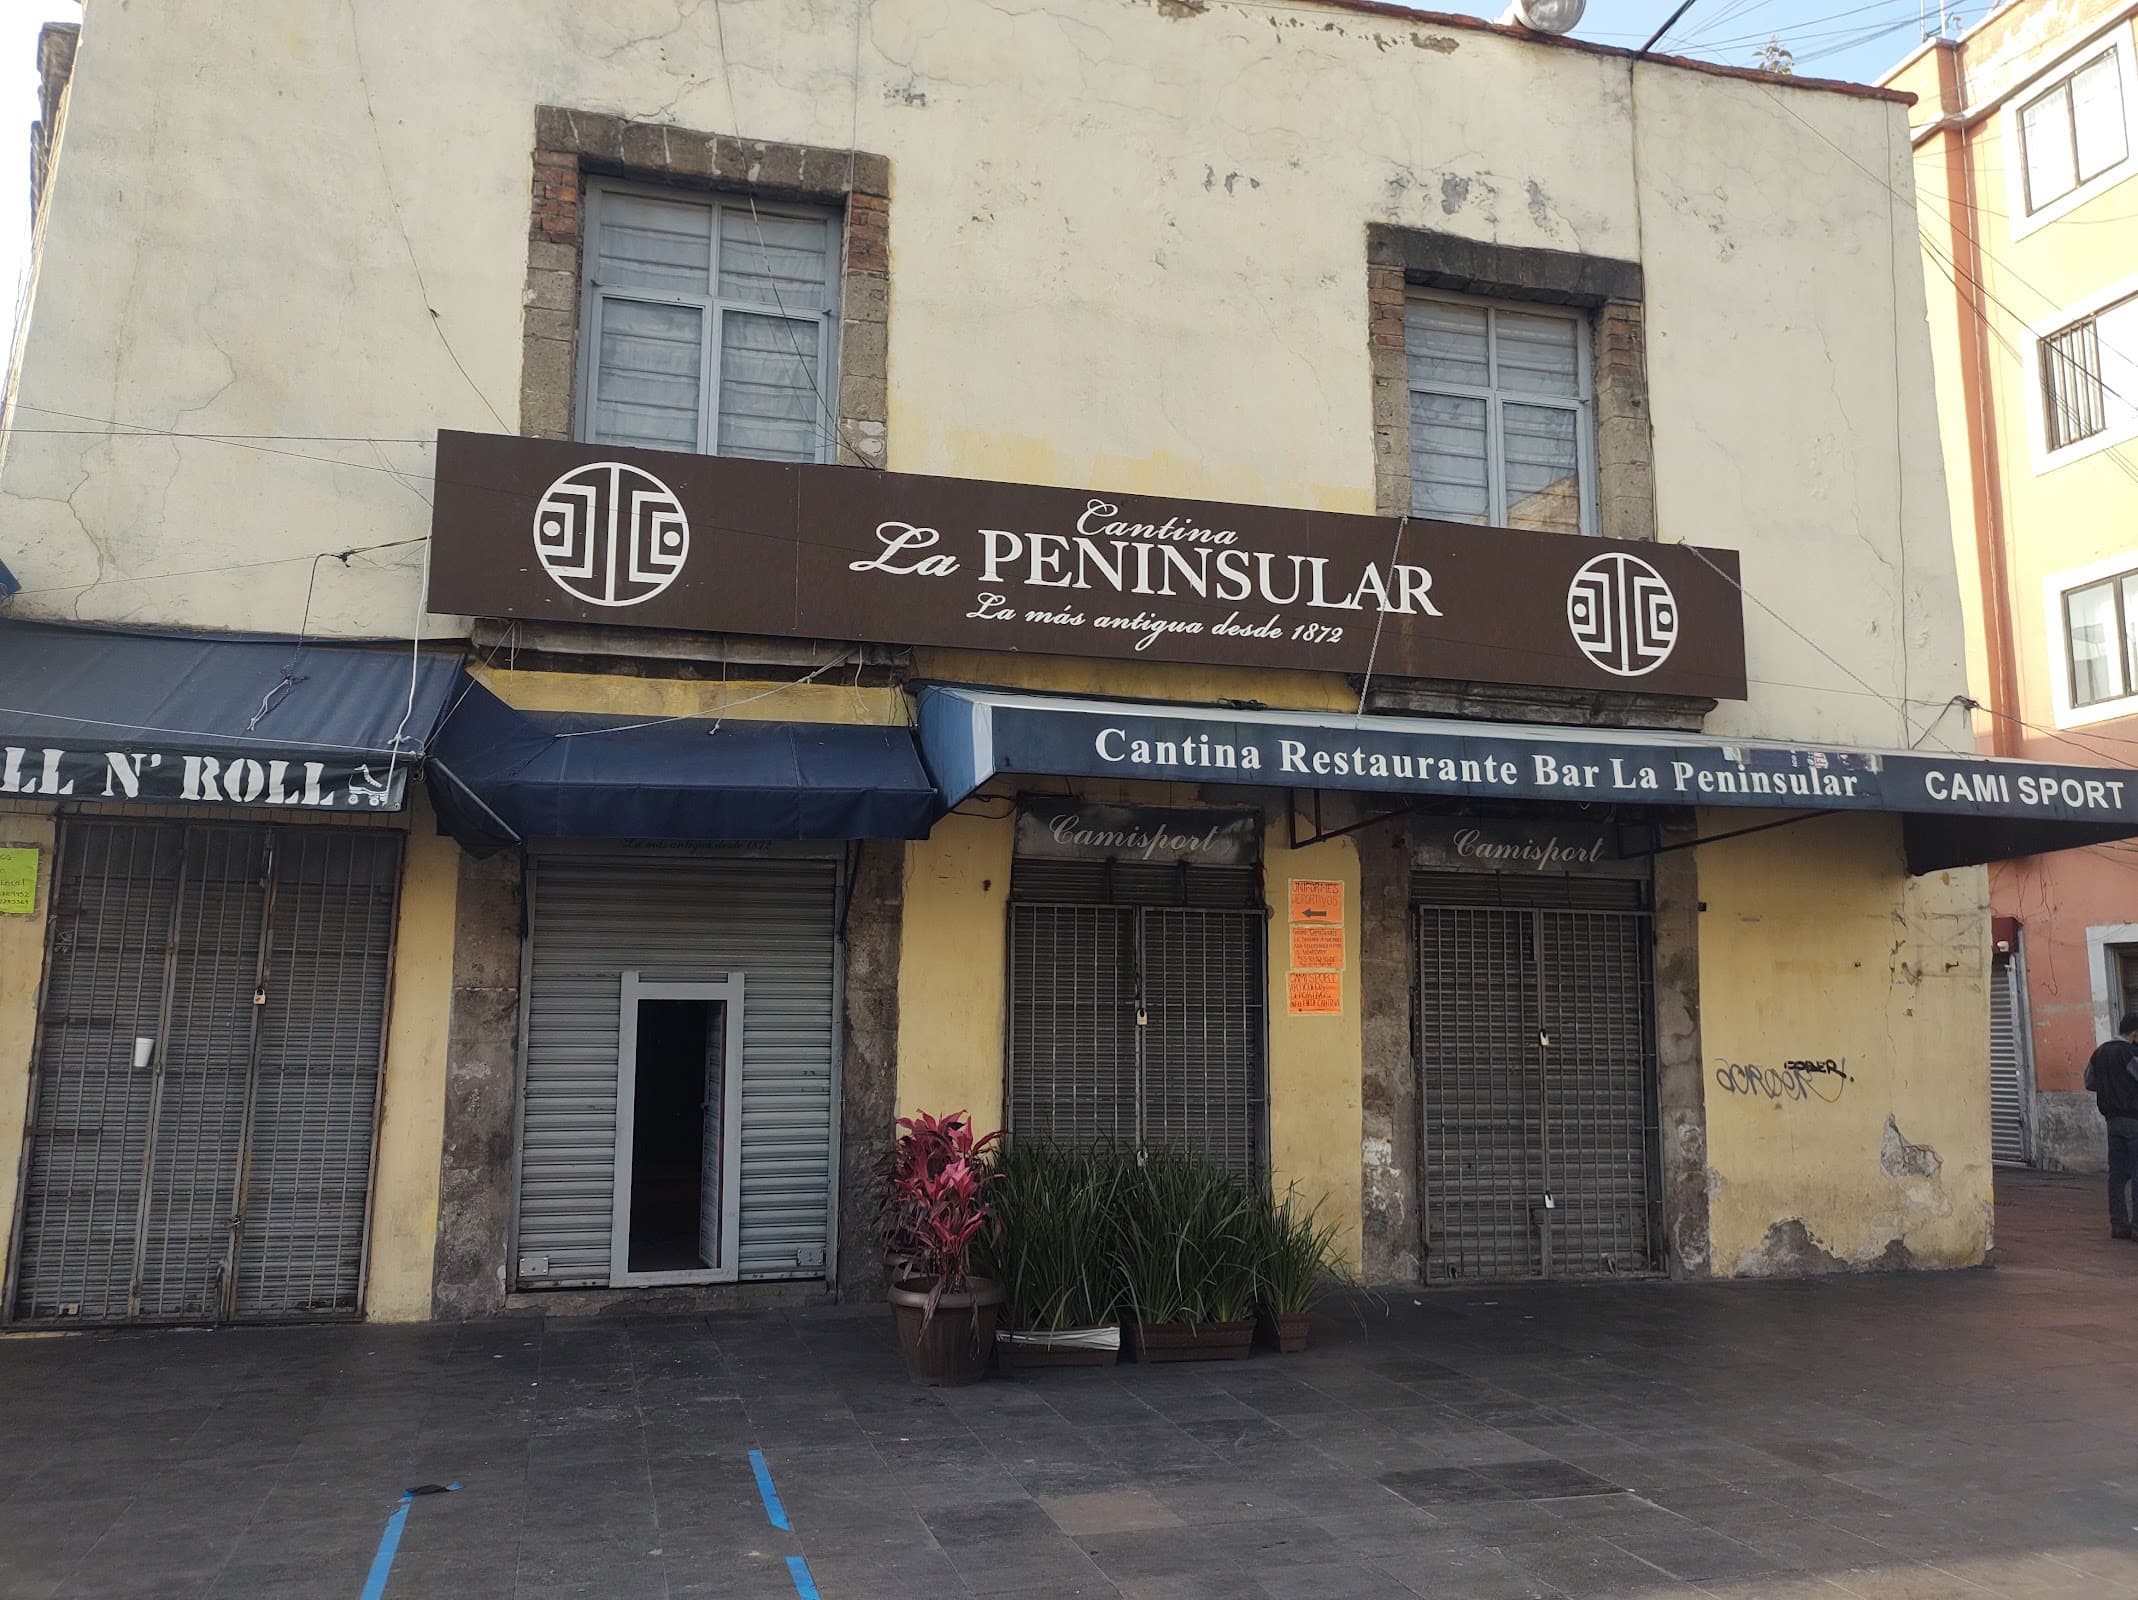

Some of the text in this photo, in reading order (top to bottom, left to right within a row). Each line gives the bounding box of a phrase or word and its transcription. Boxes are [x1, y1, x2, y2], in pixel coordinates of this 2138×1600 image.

[1076, 499, 1238, 545] Cantina
[849, 521, 1444, 619] La PENINSULAR
[966, 592, 1344, 652] La más antigua desde 1872
[100, 751, 162, 798] N'
[179, 755, 335, 806] ROLL
[1095, 728, 1262, 770] Cantina
[1278, 739, 1518, 785] Restaurante
[1532, 754, 1600, 788] Bar
[1609, 758, 1659, 789] La
[1671, 760, 1858, 797] Peninsular
[1925, 770, 2125, 809] CAMI SPORT
[1050, 814, 1218, 860] Camisport
[1453, 828, 1604, 871] Camisport
